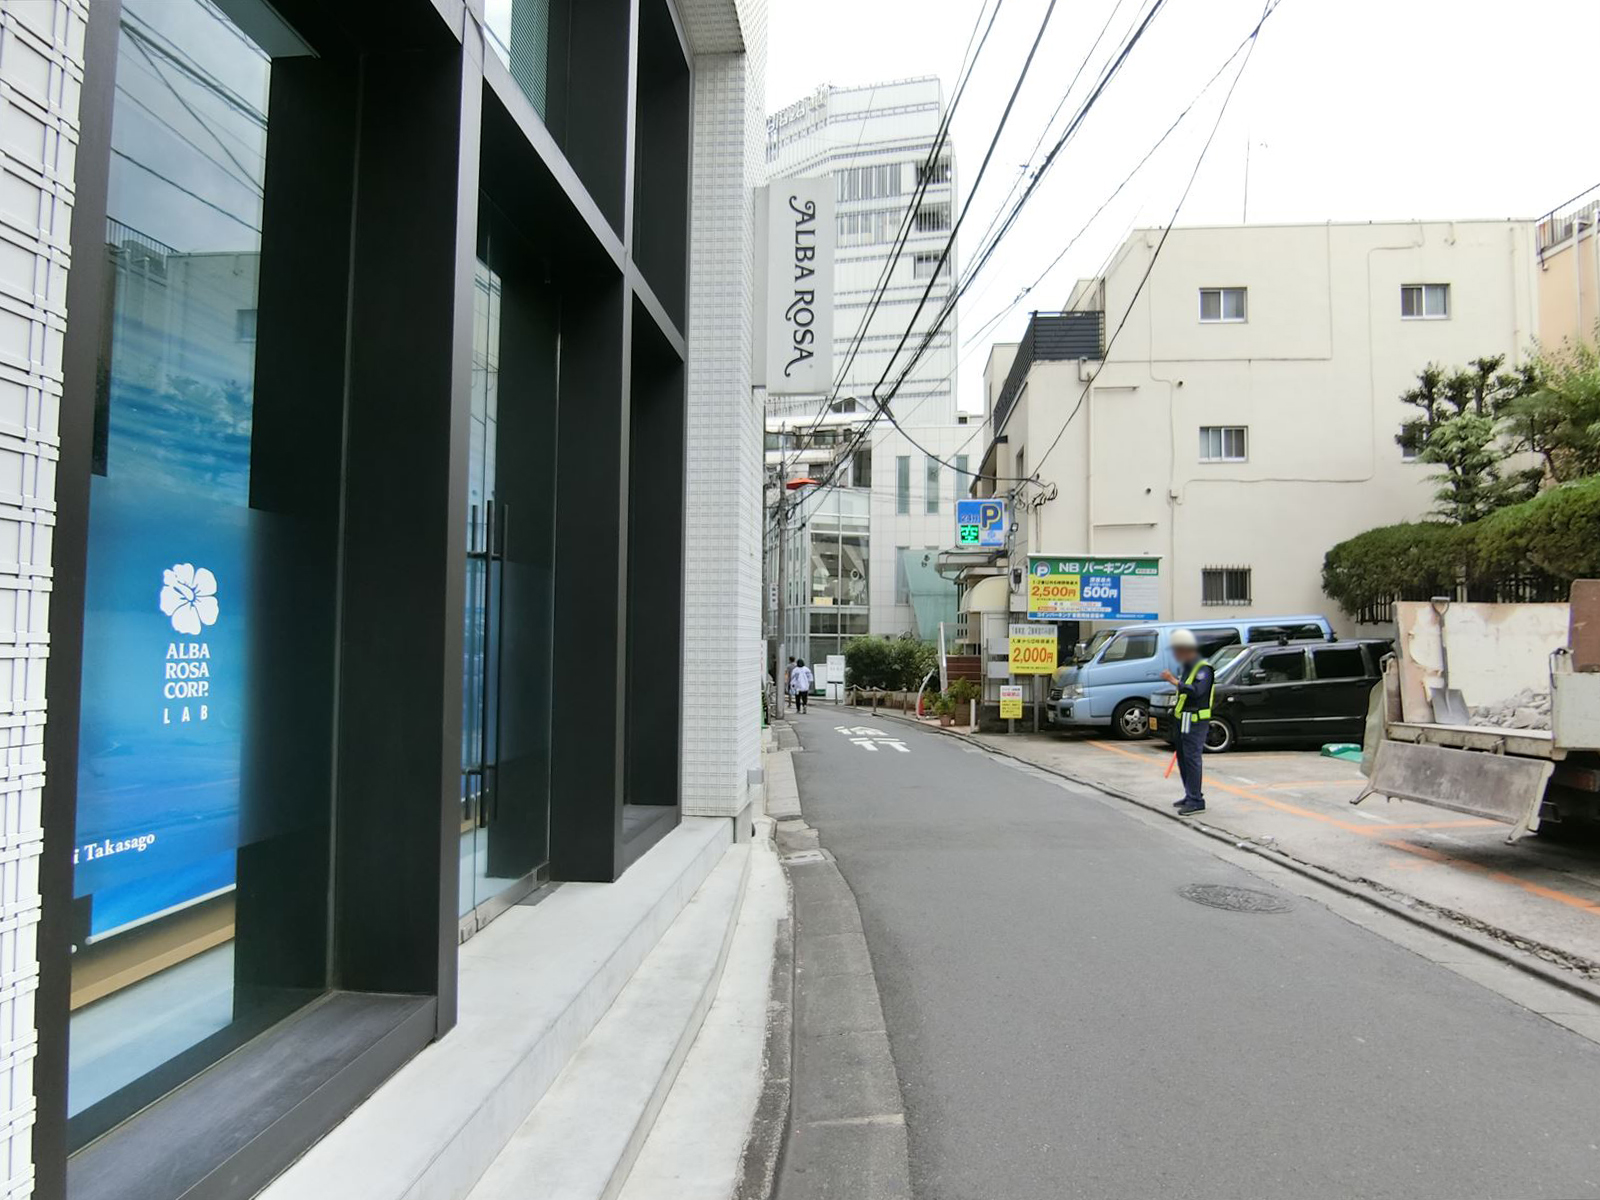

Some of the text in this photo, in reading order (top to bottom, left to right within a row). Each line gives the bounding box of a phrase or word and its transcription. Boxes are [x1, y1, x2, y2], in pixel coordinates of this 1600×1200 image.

[785, 195, 816, 378] ALBA ROSA
[980, 503, 1001, 530] P
[961, 525, 979, 543] 空
[1058, 562, 1080, 573] NB
[1083, 561, 1137, 574] パーキング
[1031, 586, 1077, 598] 2,500円
[1083, 588, 1118, 598] 500円
[166, 642, 210, 660] ALBA
[1012, 646, 1053, 663] 2,000円
[165, 662, 210, 680] ROSA
[163, 681, 209, 700] CORP.
[84, 832, 155, 862] Takasago
